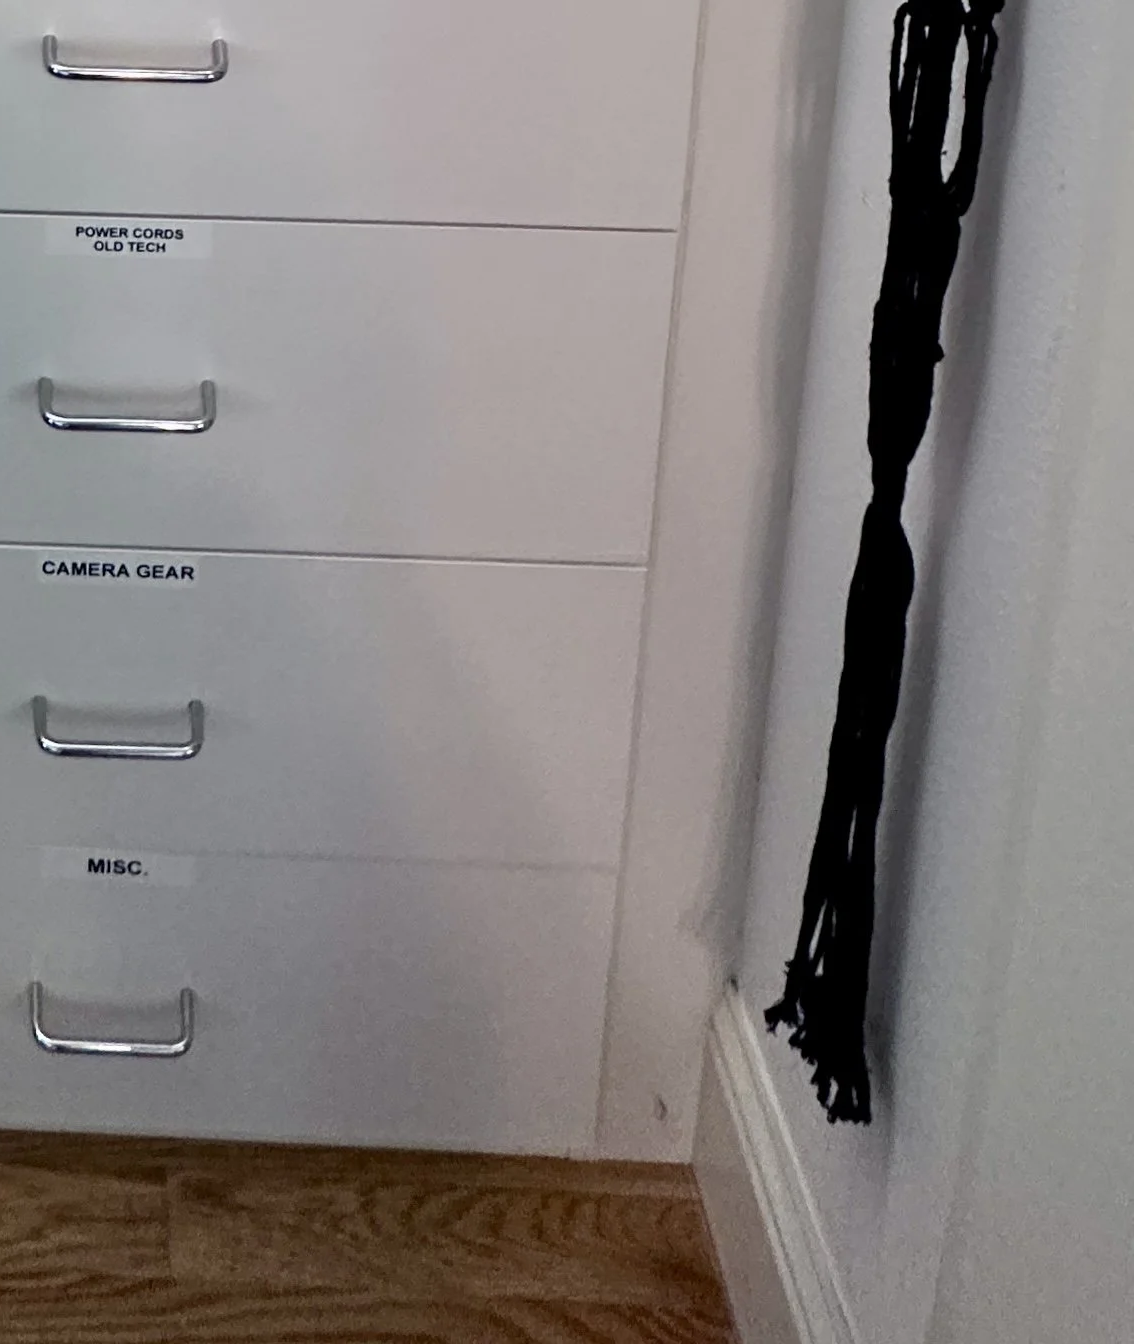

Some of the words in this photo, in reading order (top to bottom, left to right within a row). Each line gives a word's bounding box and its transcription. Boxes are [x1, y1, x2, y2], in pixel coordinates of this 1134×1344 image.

[75, 226, 128, 239] POWER
[132, 227, 184, 241] CORDS
[93, 240, 124, 253] OLD
[127, 241, 166, 253] TECH
[41, 560, 130, 579] CAMERA
[136, 563, 195, 581] GEAR
[87, 858, 149, 877] MISC.
